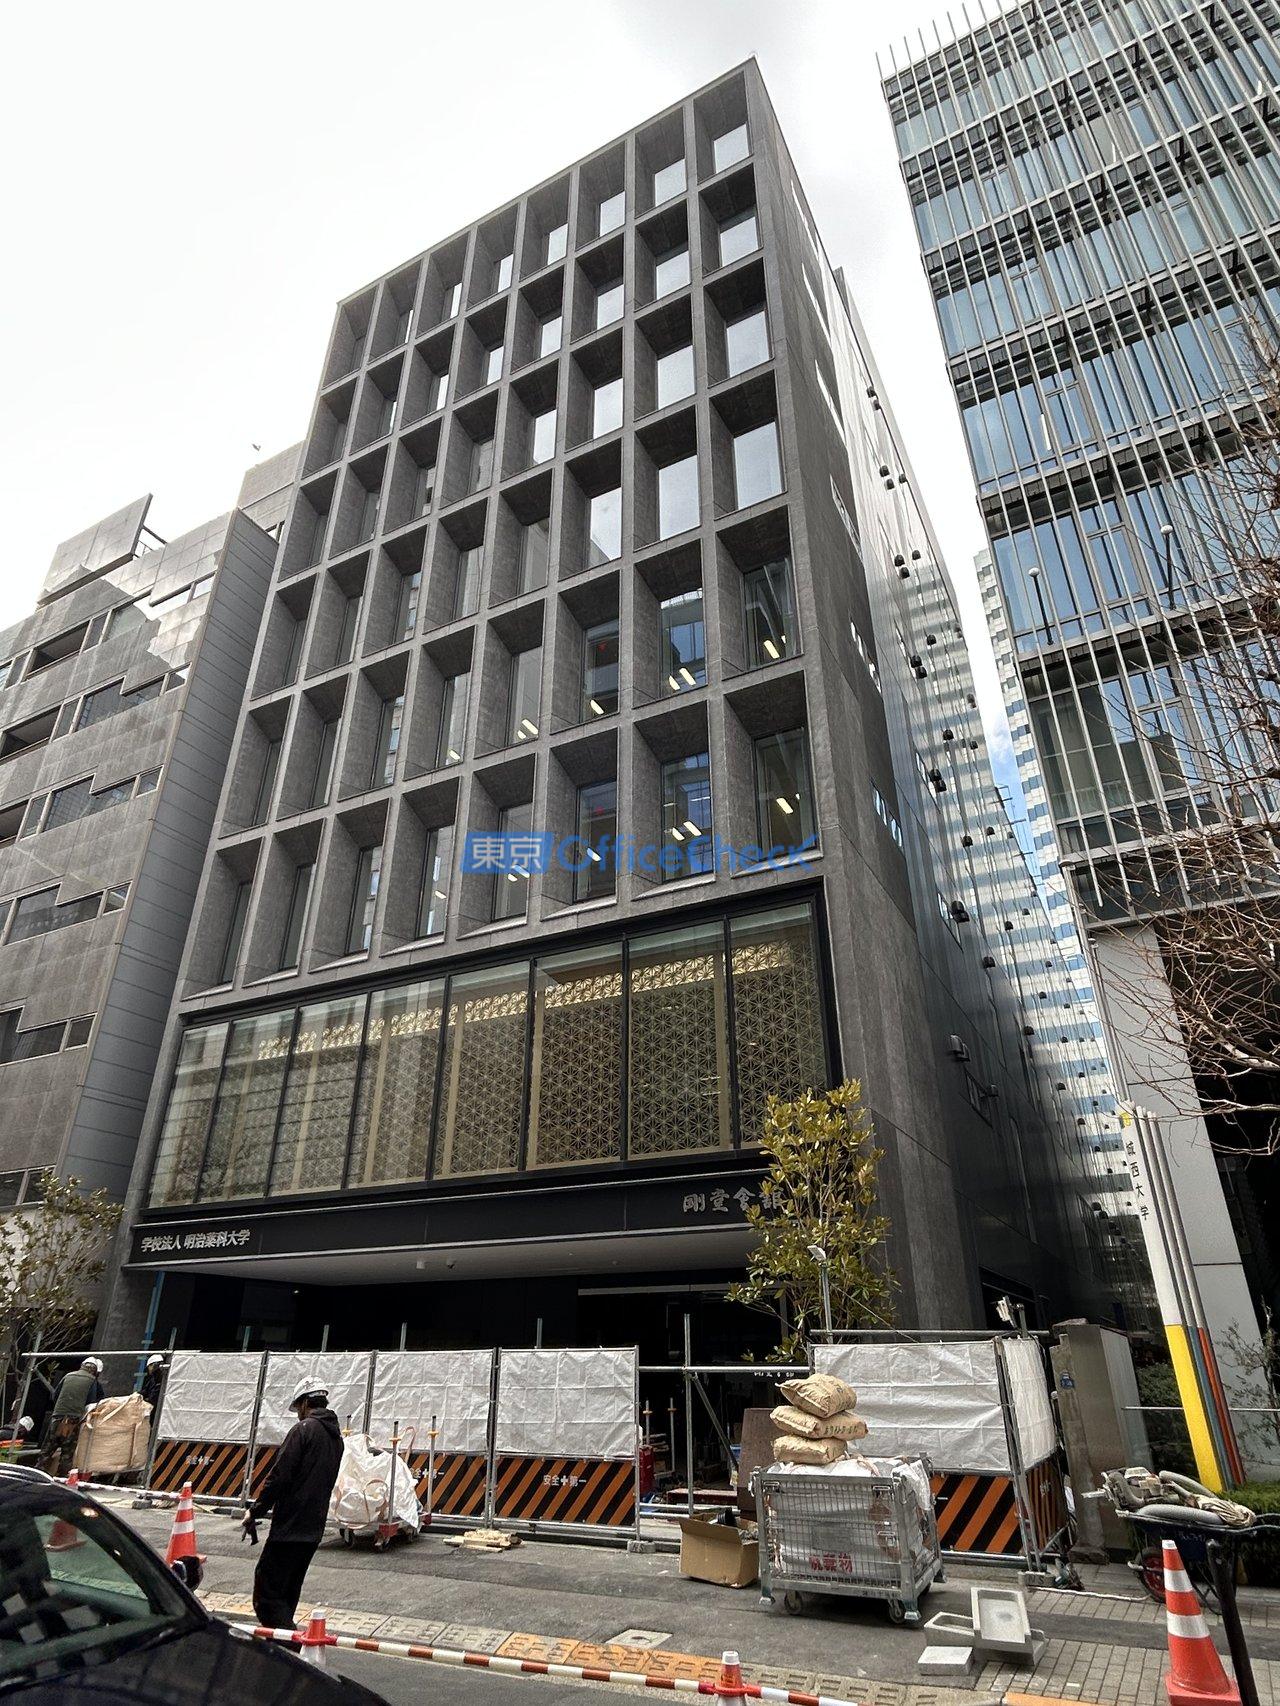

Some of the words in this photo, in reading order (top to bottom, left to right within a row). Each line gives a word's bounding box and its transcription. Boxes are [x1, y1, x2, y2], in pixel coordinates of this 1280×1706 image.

[140, 1235, 181, 1252] 学校法人
[183, 1229, 251, 1249] 明治薬科大学
